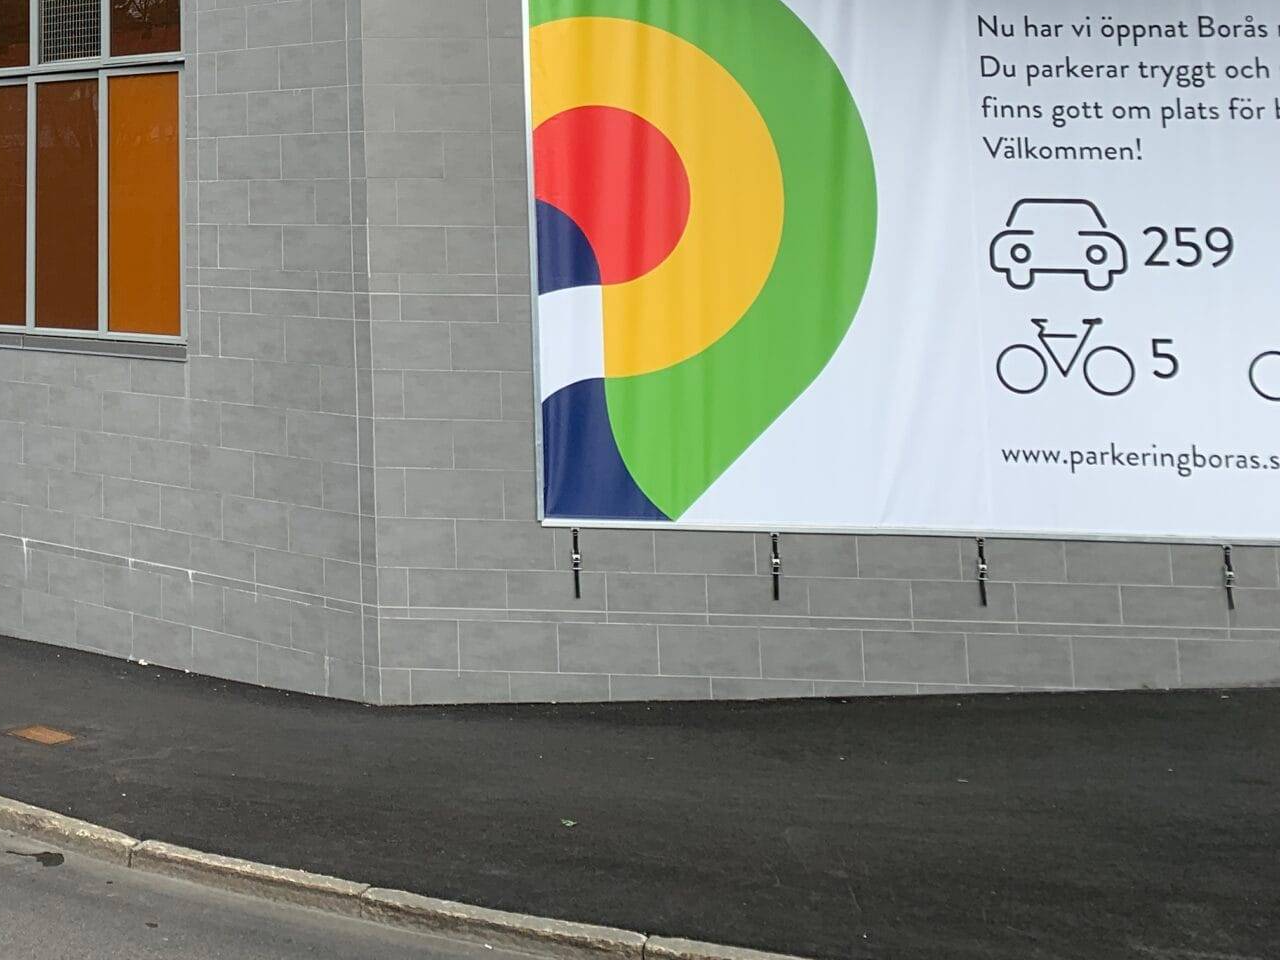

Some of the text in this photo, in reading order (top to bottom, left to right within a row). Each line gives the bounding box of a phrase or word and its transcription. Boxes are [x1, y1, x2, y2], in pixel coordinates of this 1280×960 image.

[977, 15, 1014, 38] Nu
[1024, 16, 1063, 38] har
[1072, 16, 1092, 38] vi
[1101, 16, 1188, 46] öppnat
[1198, 15, 1269, 38] Borås
[980, 55, 1270, 88] Du parkerar tryggt och
[981, 96, 1043, 118] finns
[1052, 101, 1103, 128] gott
[1112, 104, 1151, 120] om
[1161, 97, 1220, 128] plats
[1228, 97, 1266, 120] för
[982, 136, 1143, 161] Välkommen!
[1143, 226, 1234, 268] 259
[1151, 338, 1179, 379] 5
[1001, 442, 1280, 477] www.parkeringboras.s
